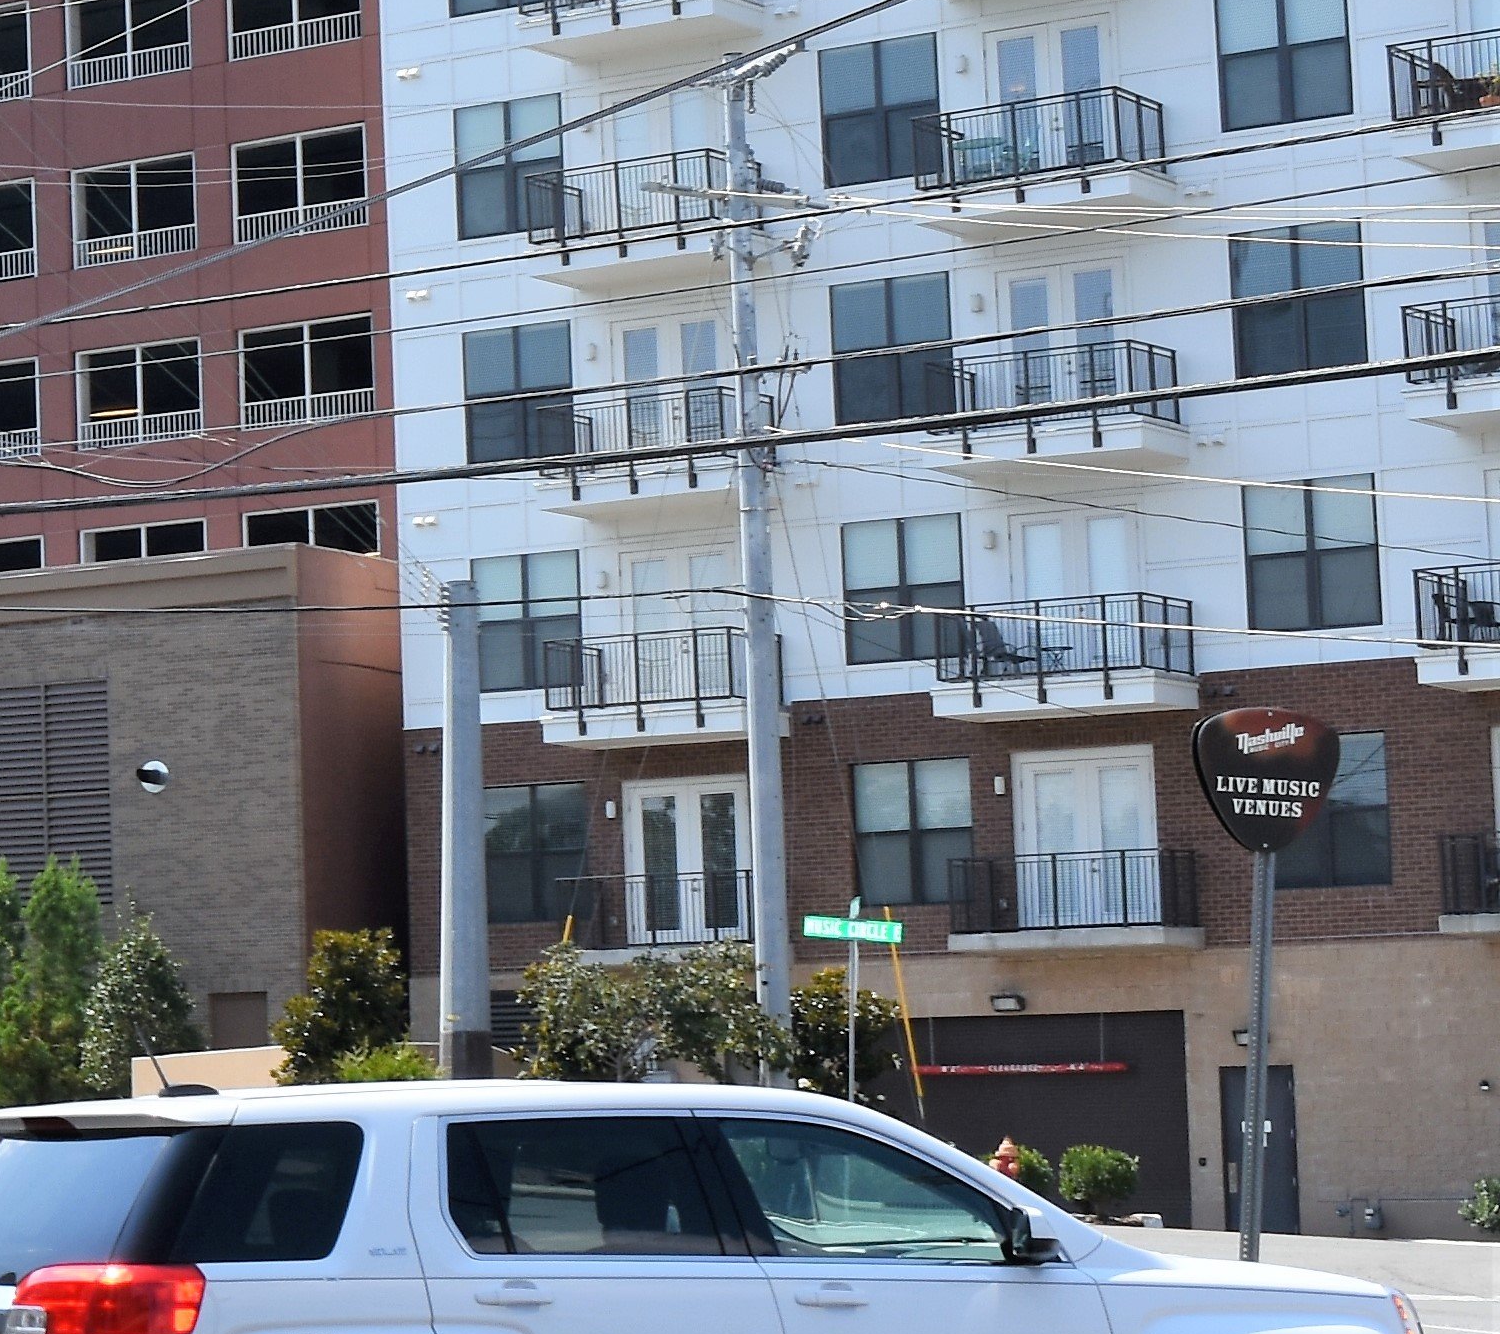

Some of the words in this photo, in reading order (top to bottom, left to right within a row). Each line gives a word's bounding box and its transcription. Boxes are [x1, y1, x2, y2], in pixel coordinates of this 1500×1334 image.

[1235, 723, 1304, 754] Nashville
[1216, 775, 1258, 794] LIVE
[1261, 778, 1321, 798] MUSIC
[1232, 798, 1303, 818] VENUES
[804, 918, 842, 937] MUSIC
[848, 922, 887, 940] CIRCLE
